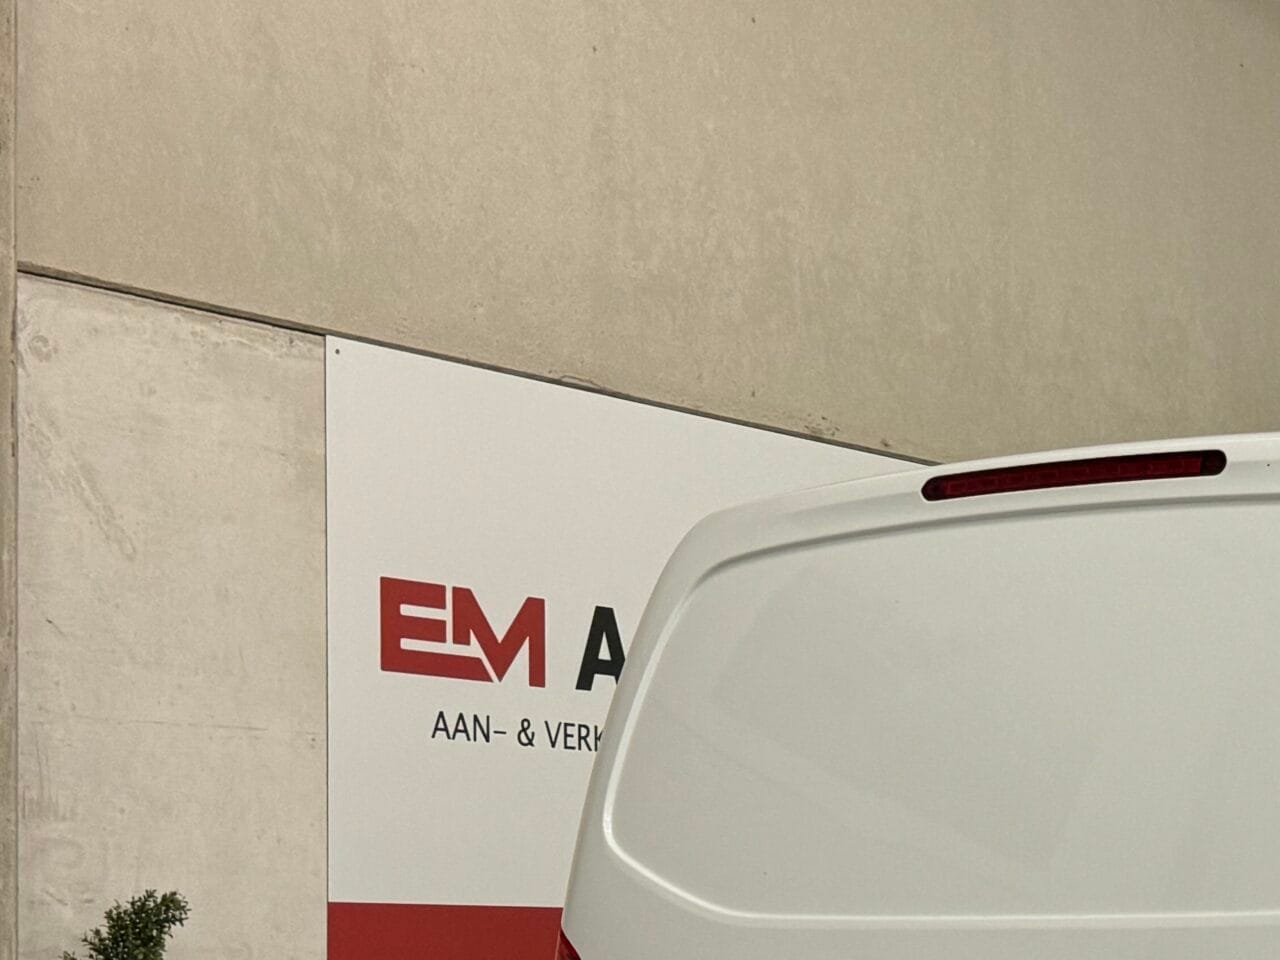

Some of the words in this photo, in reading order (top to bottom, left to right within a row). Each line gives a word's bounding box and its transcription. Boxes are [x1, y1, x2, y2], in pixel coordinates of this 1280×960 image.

[380, 576, 546, 688] EM
[575, 605, 626, 691] A
[431, 711, 507, 743] AAN-
[517, 718, 535, 747] &
